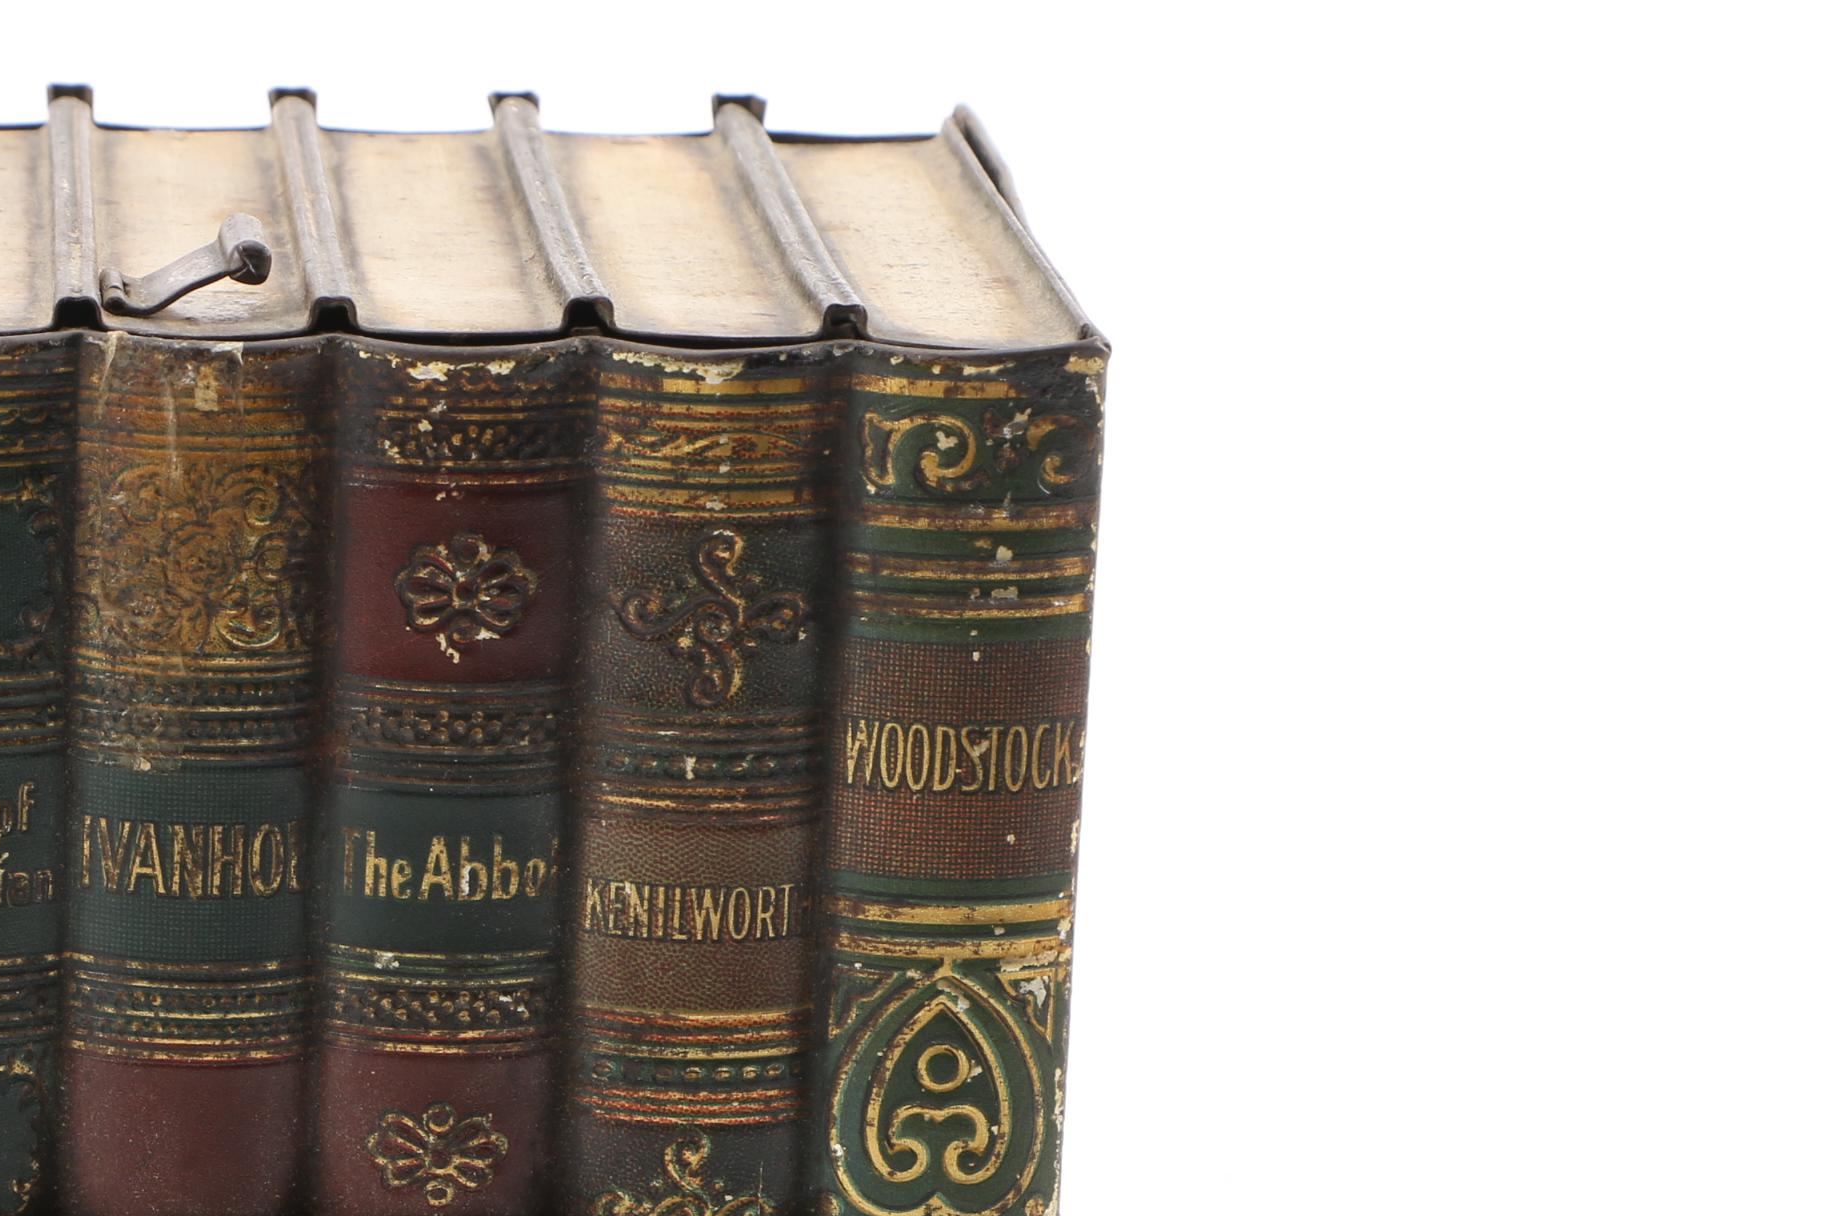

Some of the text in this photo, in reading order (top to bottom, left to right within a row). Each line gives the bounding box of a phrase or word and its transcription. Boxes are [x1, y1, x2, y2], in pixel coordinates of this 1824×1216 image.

[845, 718, 1075, 793] WOODSTOCK
[340, 824, 412, 898] The
[583, 878, 796, 941] KENILWORT
